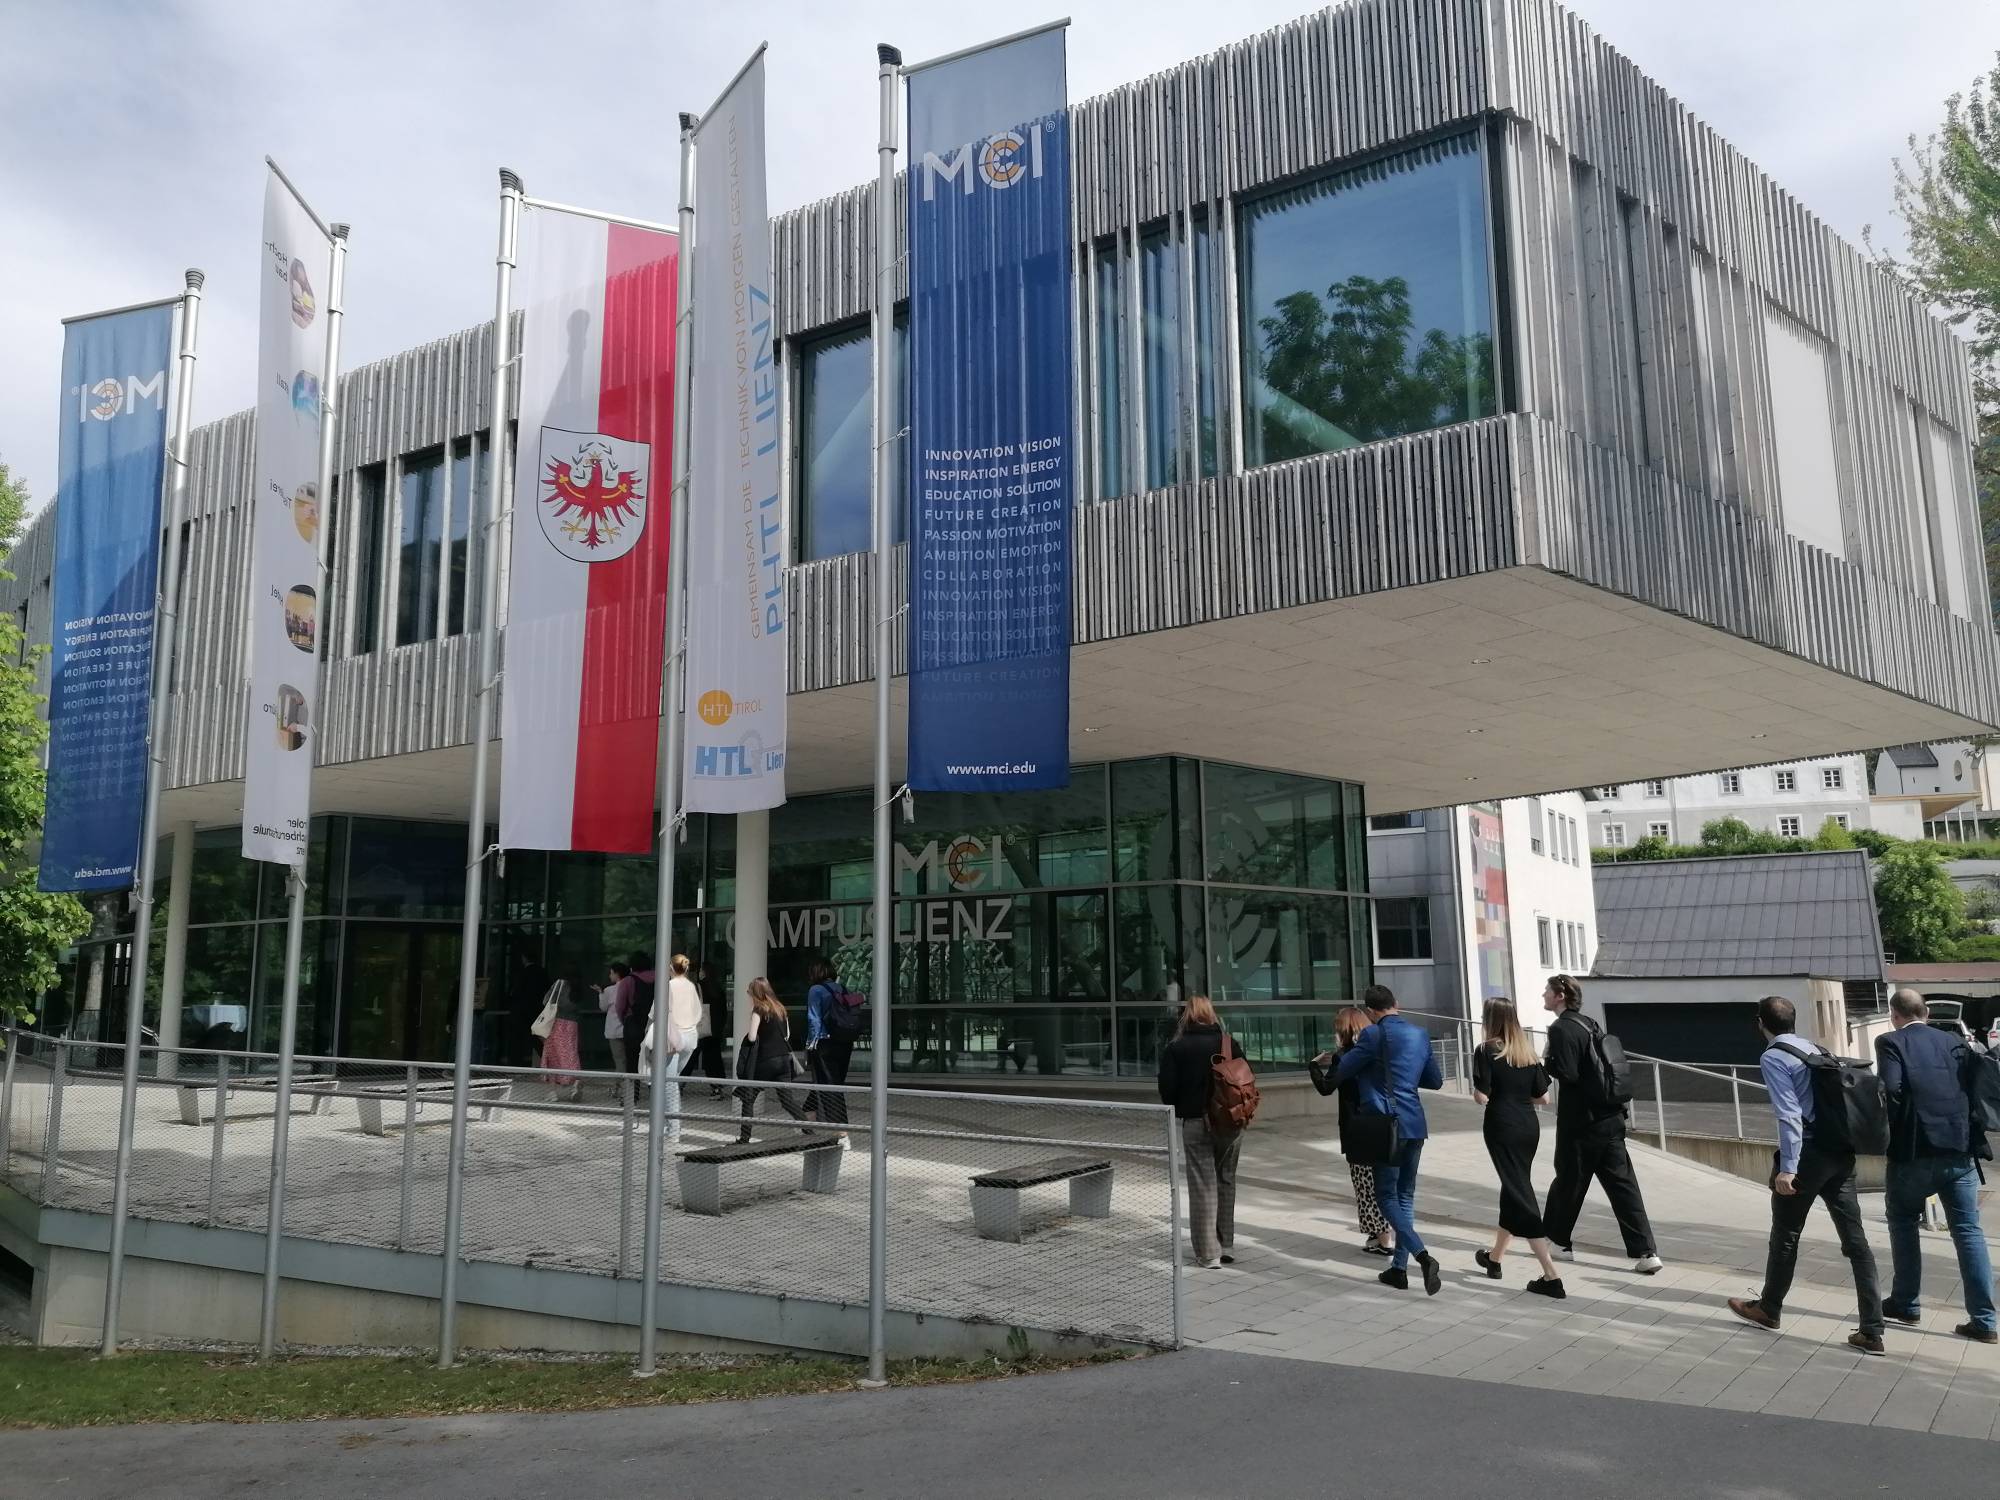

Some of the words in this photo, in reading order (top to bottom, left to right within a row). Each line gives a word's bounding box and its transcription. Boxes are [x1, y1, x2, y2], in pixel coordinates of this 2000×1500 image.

[732, 232, 746, 324] MORGEN
[735, 329, 747, 377] VON
[737, 380, 750, 472] TECHNIK
[925, 445, 1014, 461] INNOVATION
[1019, 436, 1061, 454] VISION
[925, 466, 1009, 481] INSPIRATION
[1013, 457, 1061, 476] ENERGY
[742, 480, 753, 513] DIE
[925, 488, 1003, 501] EDUCATION
[1007, 478, 1061, 497] SOLUTION
[925, 509, 984, 521] FUTURE
[991, 499, 1061, 519] CREATION
[924, 529, 982, 541] PASSION
[986, 520, 1061, 540] MOTIVATION
[924, 549, 995, 561] AMBITION
[1001, 541, 1061, 559] EMOTION
[744, 519, 761, 639] GEMEINSAM
[923, 561, 1061, 581] COLLABORATION
[923, 589, 1014, 601] INNOVATION
[1019, 583, 1061, 598] VISION
[922, 609, 1008, 622] INSPIRATION
[1012, 604, 1061, 619] ENERGY
[922, 630, 1002, 642] EDUCATION
[1006, 625, 1061, 640] SOLUTION
[703, 703, 731, 717] HTL
[695, 745, 752, 776] HTL
[946, 761, 1036, 775] www.mci.edu
[893, 898, 1013, 943] LIENZ
